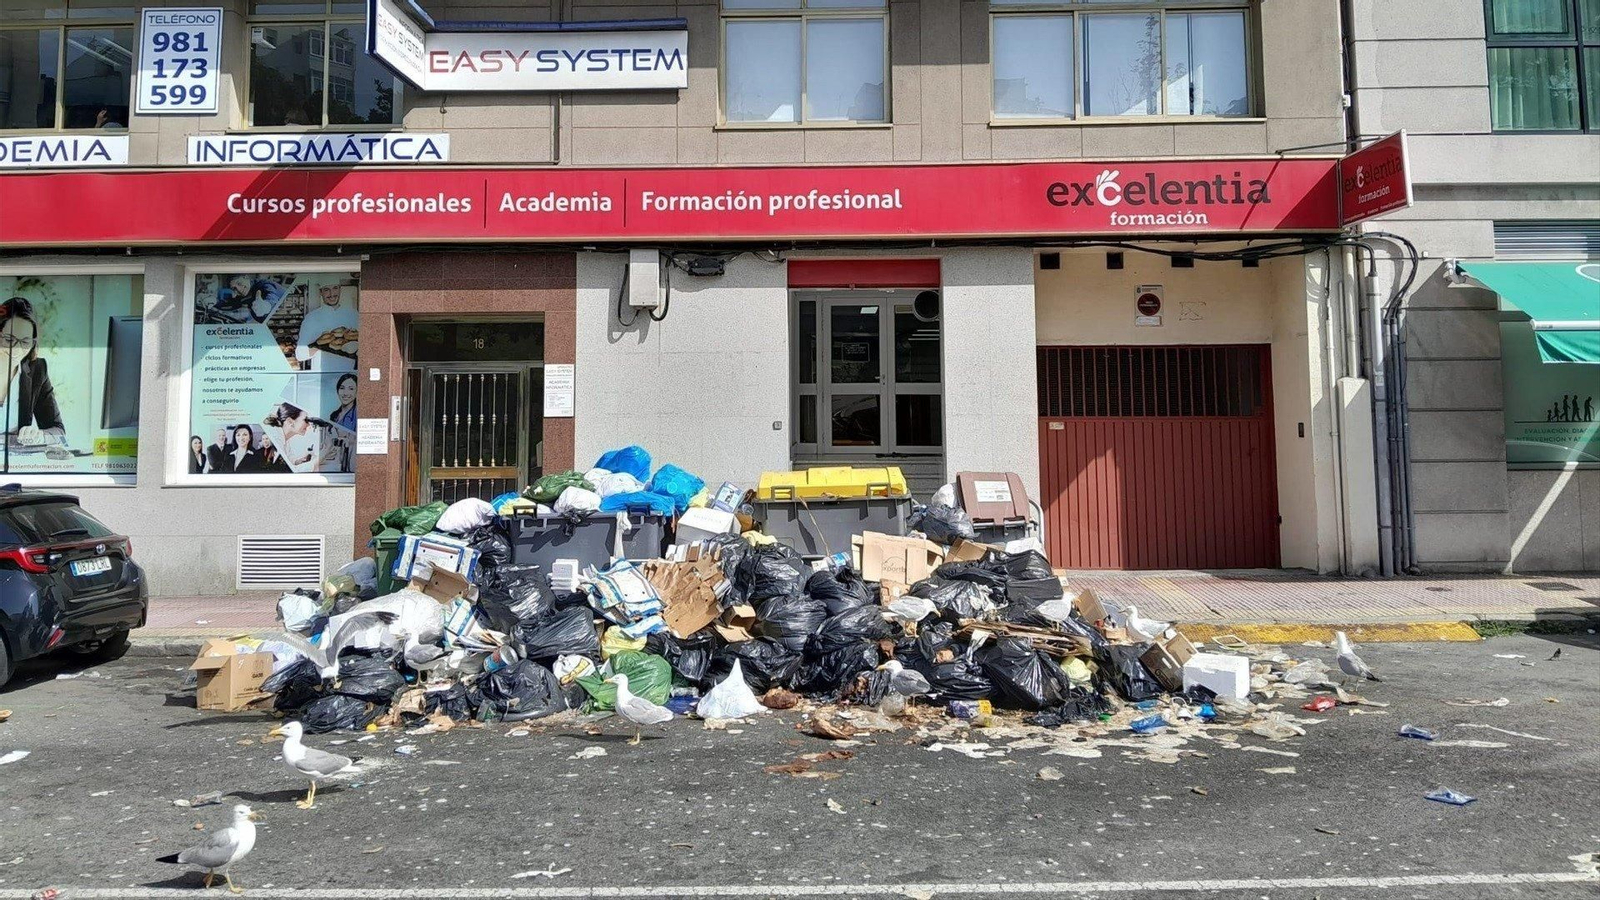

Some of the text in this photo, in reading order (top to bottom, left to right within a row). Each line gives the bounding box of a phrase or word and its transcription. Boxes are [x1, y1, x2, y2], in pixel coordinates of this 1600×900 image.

[148, 14, 216, 24] TELÉFONO
[152, 31, 209, 53] 981
[152, 58, 208, 79] 173
[429, 50, 530, 73] EASY
[536, 48, 685, 72] SYSTEM
[149, 84, 207, 106] 599
[196, 134, 443, 162] INFORMÁTICA
[1046, 170, 1272, 207] excelentia
[227, 192, 472, 219] Cursos profesionales
[499, 191, 612, 213] Academia
[641, 188, 903, 216] Formación profesional
[1109, 210, 1209, 227] formación
[206, 327, 254, 336] excelentia
[472, 338, 485, 349] 18
